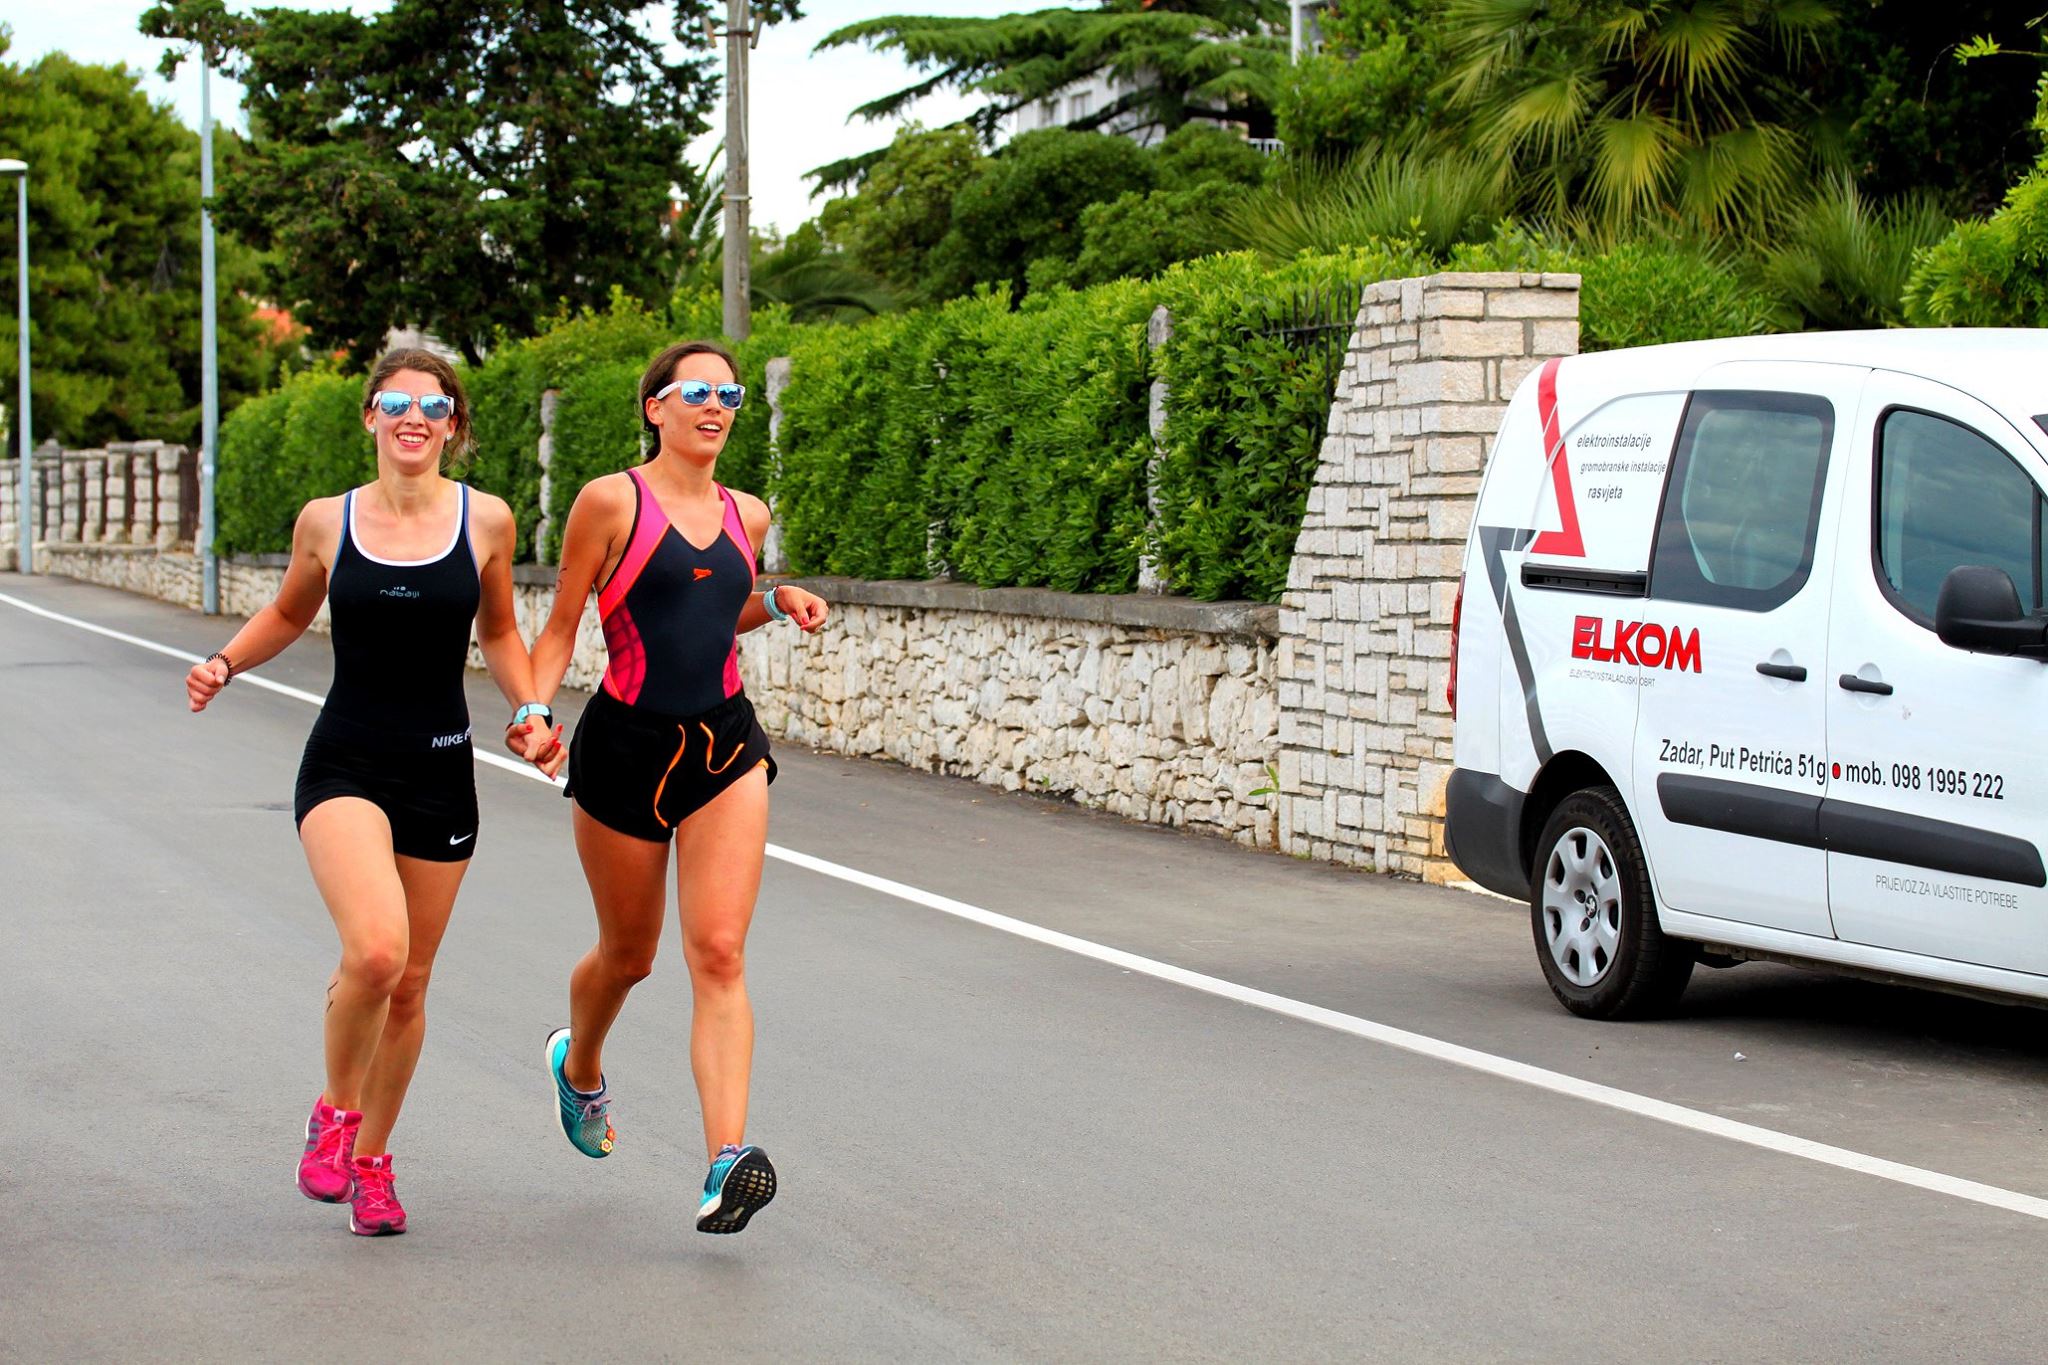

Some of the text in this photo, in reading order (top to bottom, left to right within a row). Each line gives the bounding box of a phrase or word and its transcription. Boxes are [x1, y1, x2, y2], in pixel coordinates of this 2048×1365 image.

[1577, 433, 1651, 451] elektroinstalacije
[1580, 461, 1666, 475] gromobranske instalacije
[1588, 484, 1623, 502] rasvjeta
[1571, 615, 1702, 674] ELKOM
[432, 733, 464, 748] NIKE
[1659, 739, 2004, 800] Zadar, Put Petrića 51g mob. 098 1995 222
[1876, 875, 2019, 909] PRIJEVOZ ZA VLASTITE POTREBE
